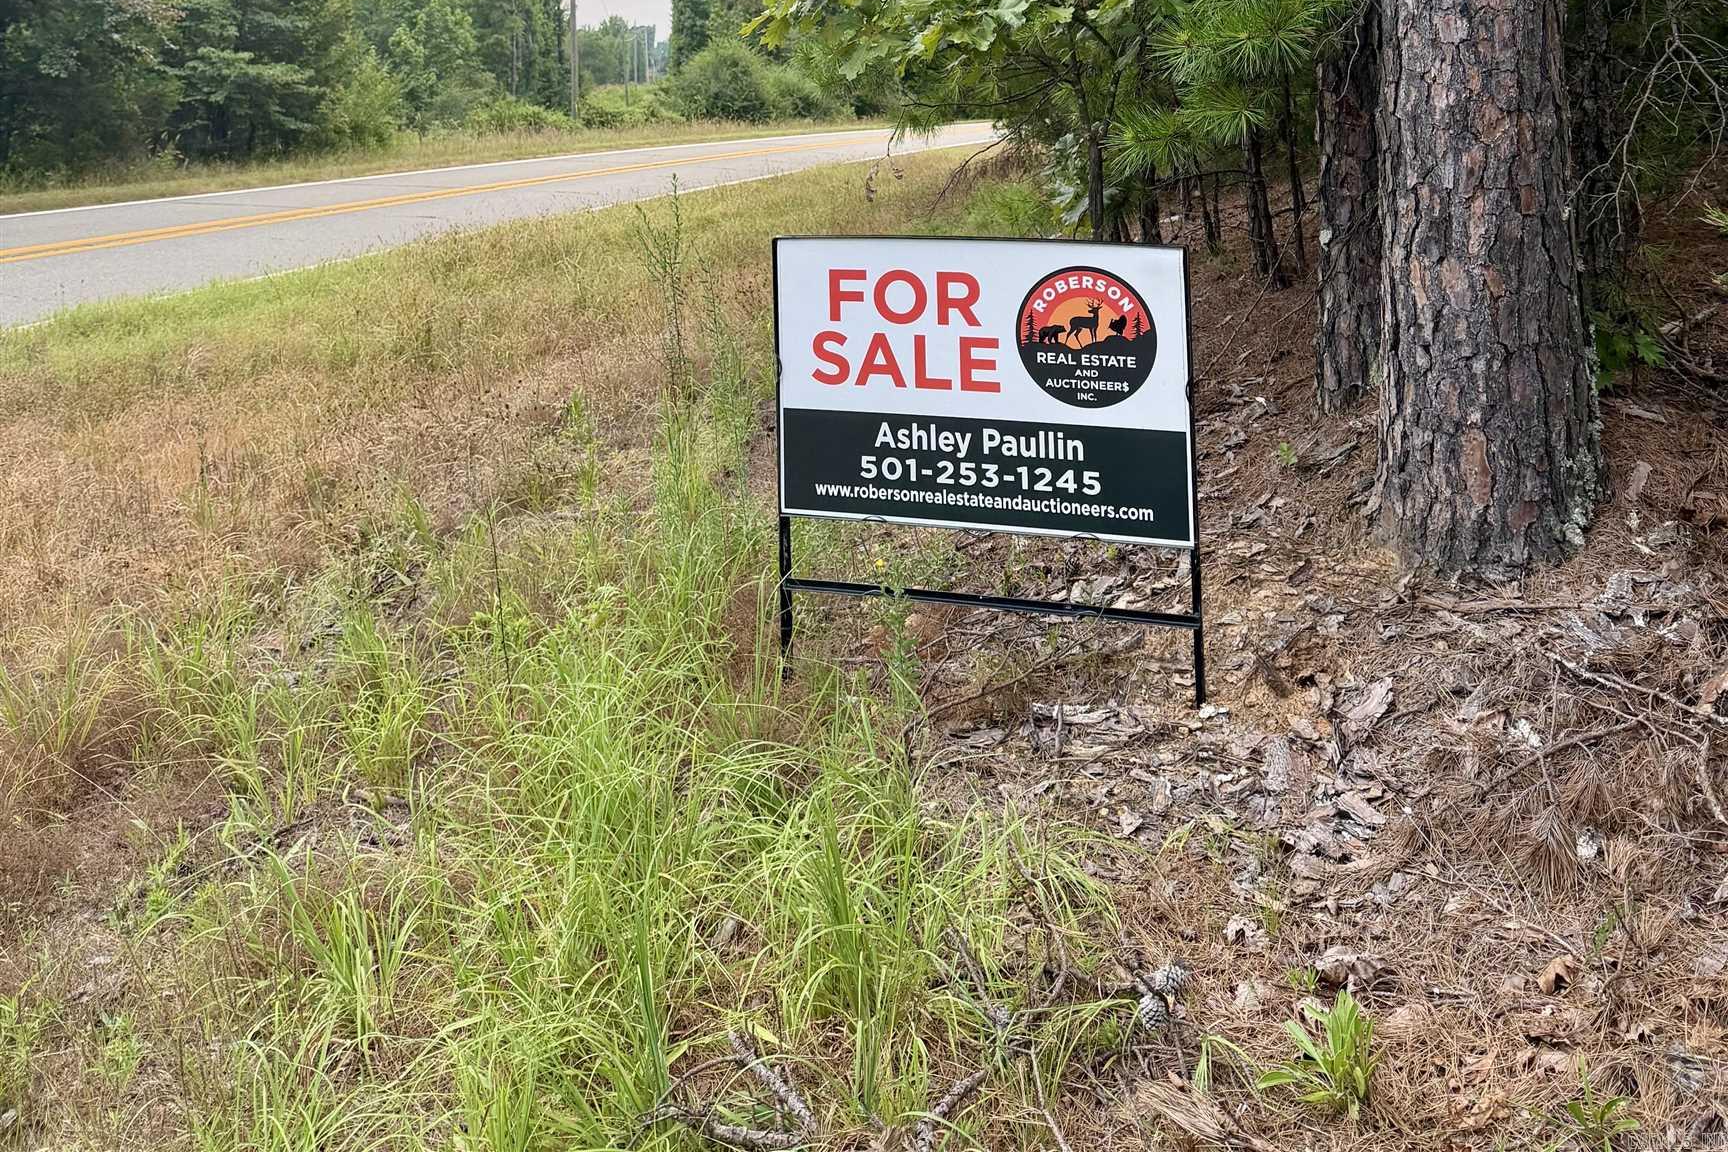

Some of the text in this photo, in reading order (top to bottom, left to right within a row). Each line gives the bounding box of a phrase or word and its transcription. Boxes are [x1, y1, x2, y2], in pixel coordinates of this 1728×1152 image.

[828, 268, 982, 327] FOR
[1032, 276, 1135, 313] ROBERSON
[811, 331, 1001, 394] SALE
[1036, 352, 1137, 368] REAL ESTATE
[1074, 369, 1099, 378] AND
[1077, 392, 1097, 401] INC.
[874, 421, 1085, 462] Ashley Paullin
[859, 455, 1102, 495] 501-253-1245
[815, 482, 1155, 522] www.robersonrealestateandauctioneers.com
